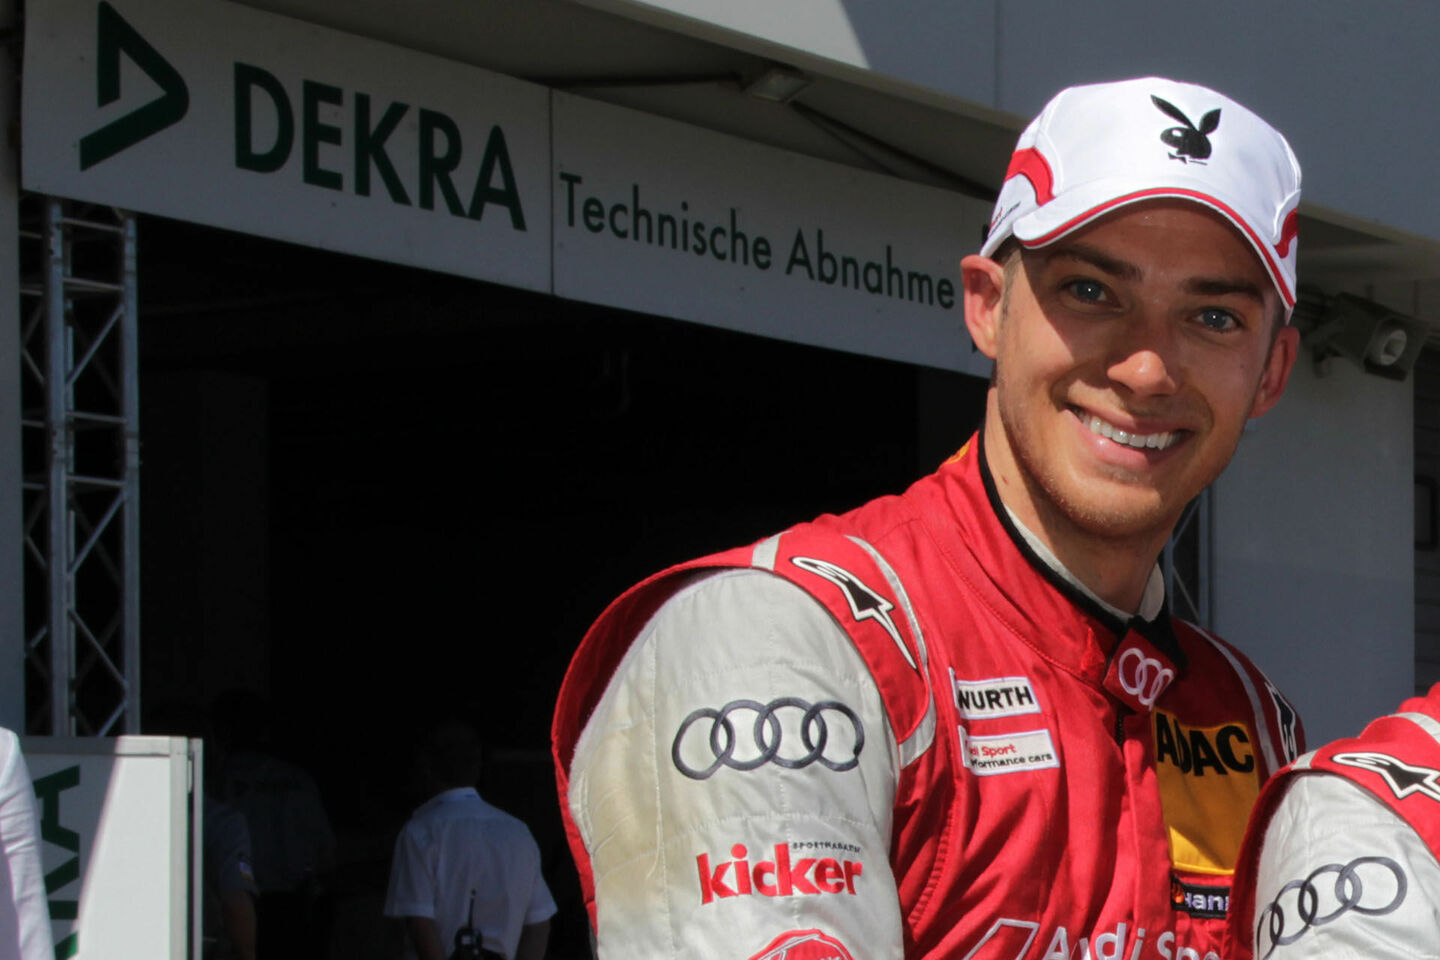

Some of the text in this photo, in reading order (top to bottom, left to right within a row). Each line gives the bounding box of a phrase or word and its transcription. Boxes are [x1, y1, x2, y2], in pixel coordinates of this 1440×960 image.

[234, 61, 527, 232] DEKRA
[559, 172, 956, 310] Technische Abnahme
[981, 744, 1017, 758] Sport
[697, 843, 863, 905] kicker
